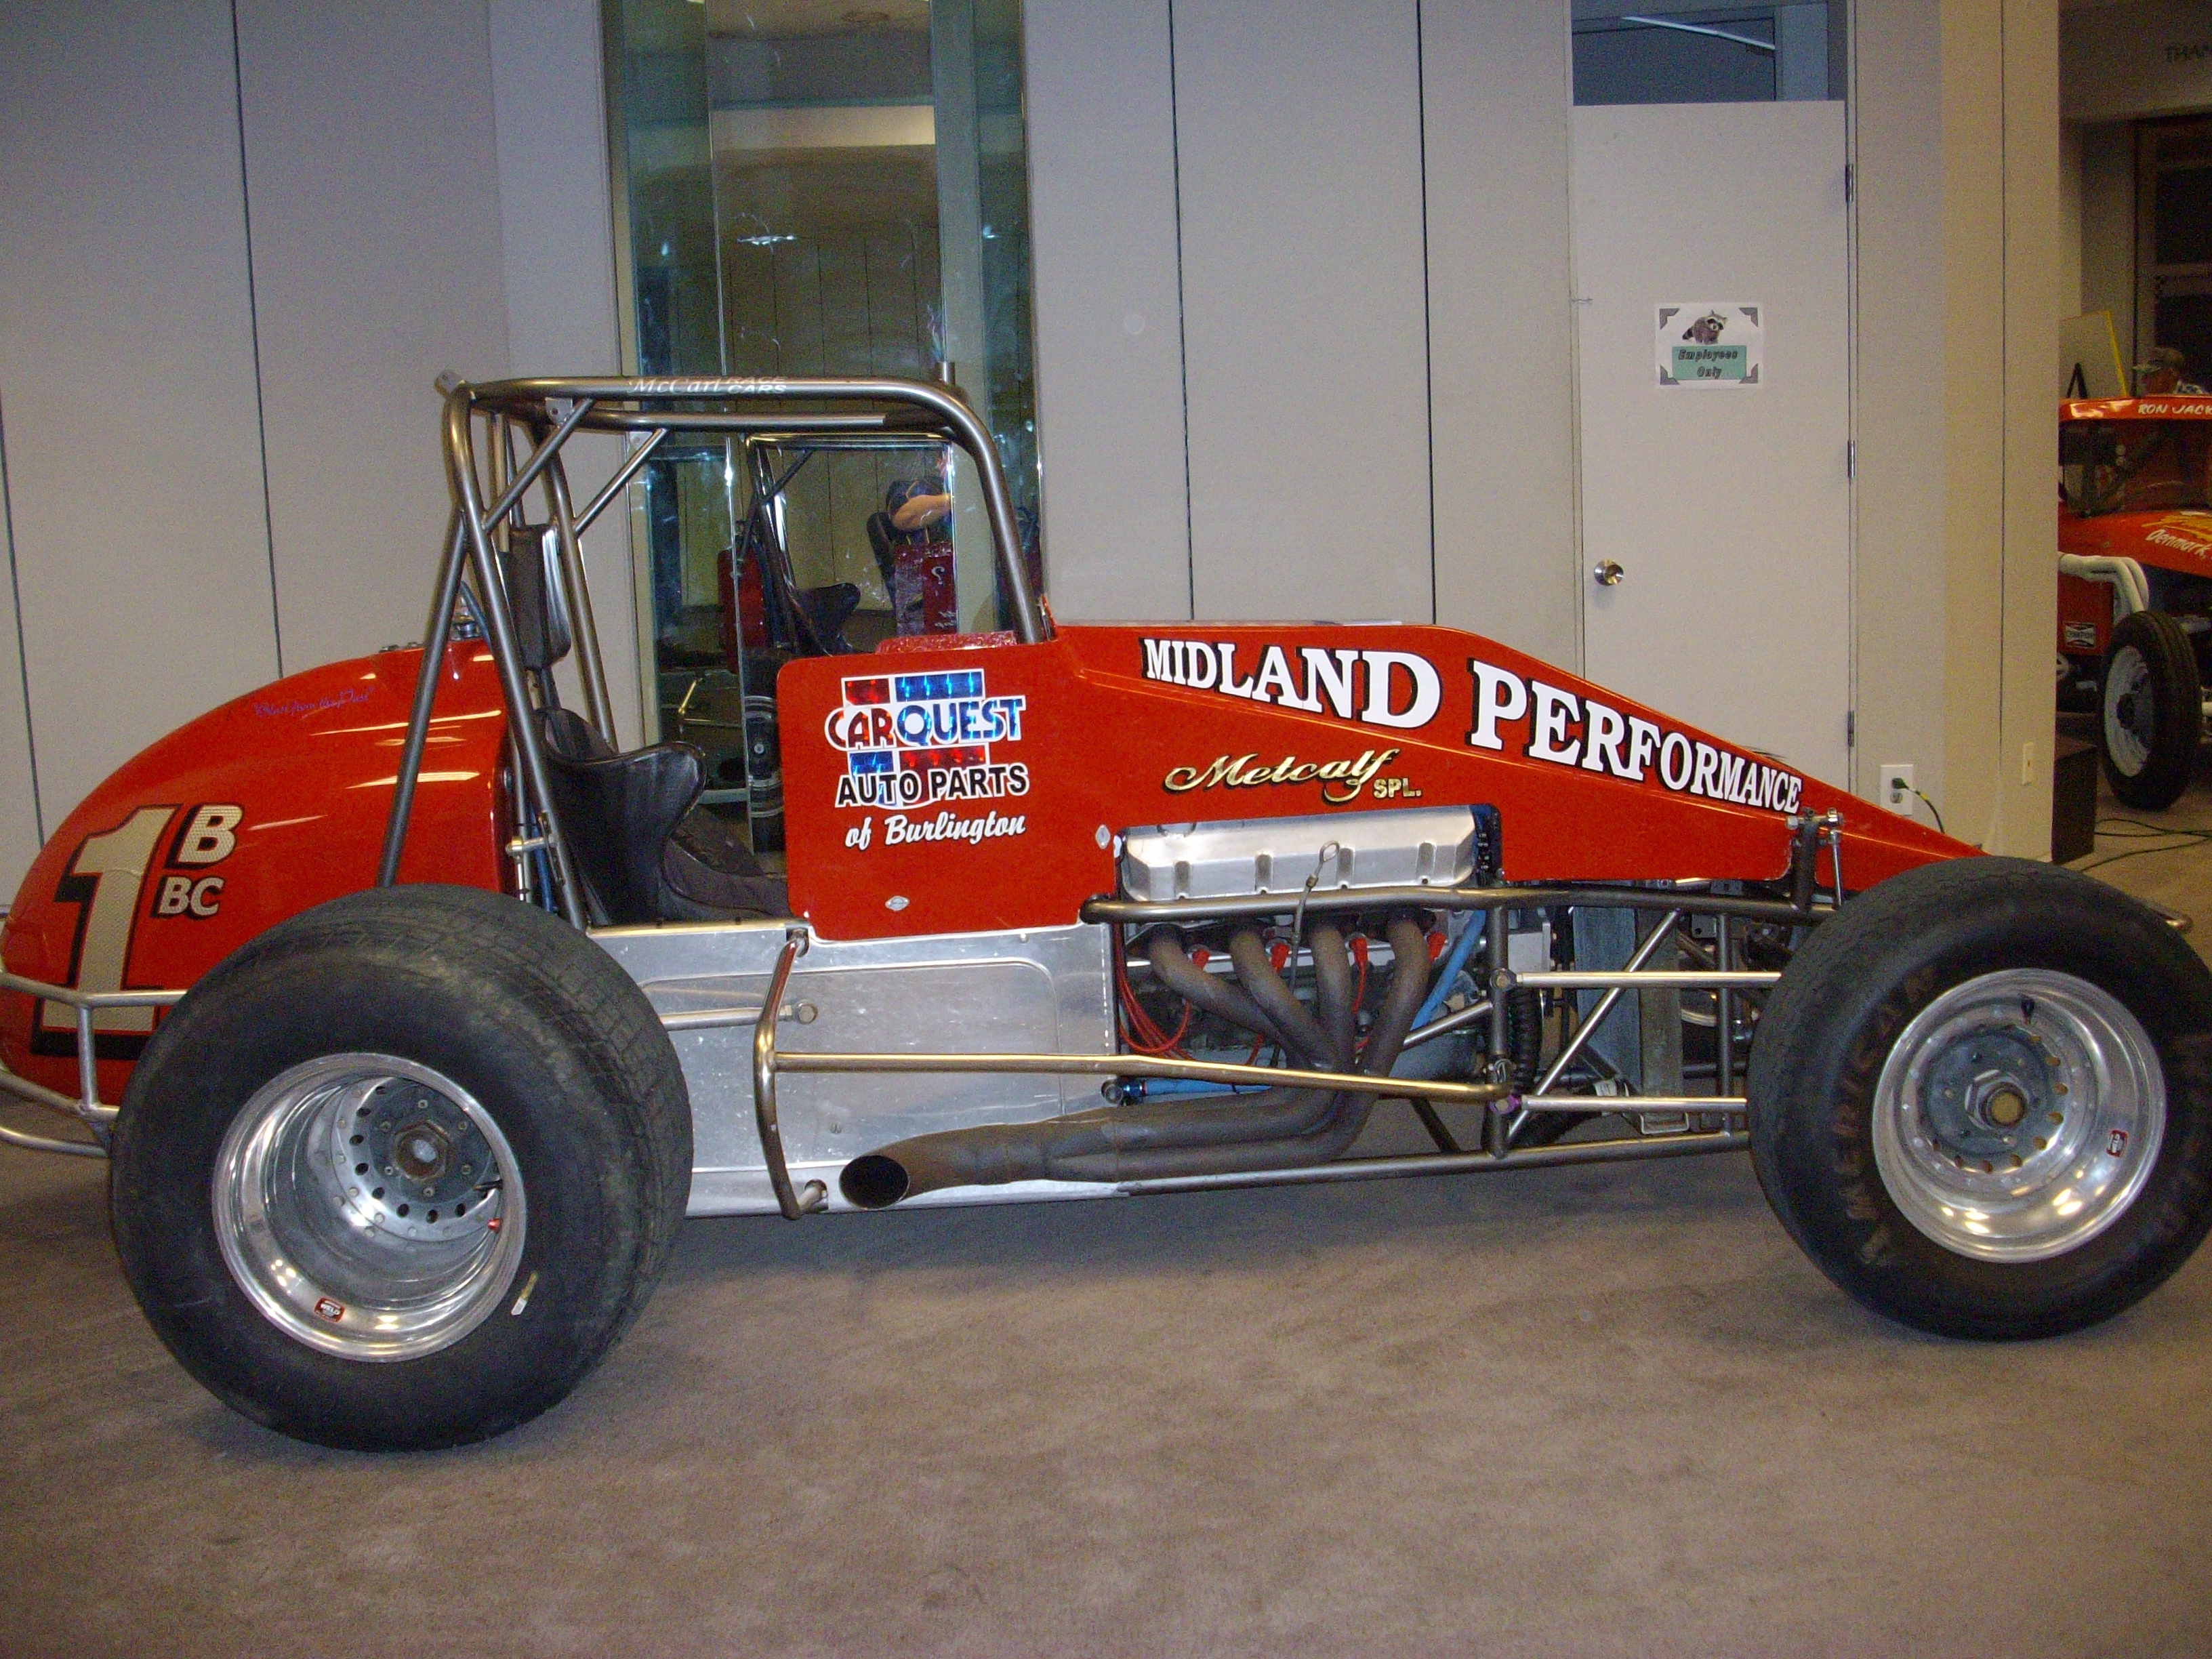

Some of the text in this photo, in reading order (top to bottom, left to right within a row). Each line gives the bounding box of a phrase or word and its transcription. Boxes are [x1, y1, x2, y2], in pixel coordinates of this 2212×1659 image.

[1678, 349, 1738, 362] Employees
[1697, 367, 1722, 379] Only
[728, 384, 787, 394] CARS
[2137, 404, 2168, 415] RON
[824, 695, 1026, 751] CARQUEST
[1141, 638, 1803, 813] MIDLAND PERFORMANCE
[835, 762, 1029, 808] AUTO PARTS
[1164, 748, 1422, 802] Metcalf SPL.
[176, 804, 244, 864] B
[844, 811, 1026, 851] of Burlington
[158, 875, 225, 916] BC
